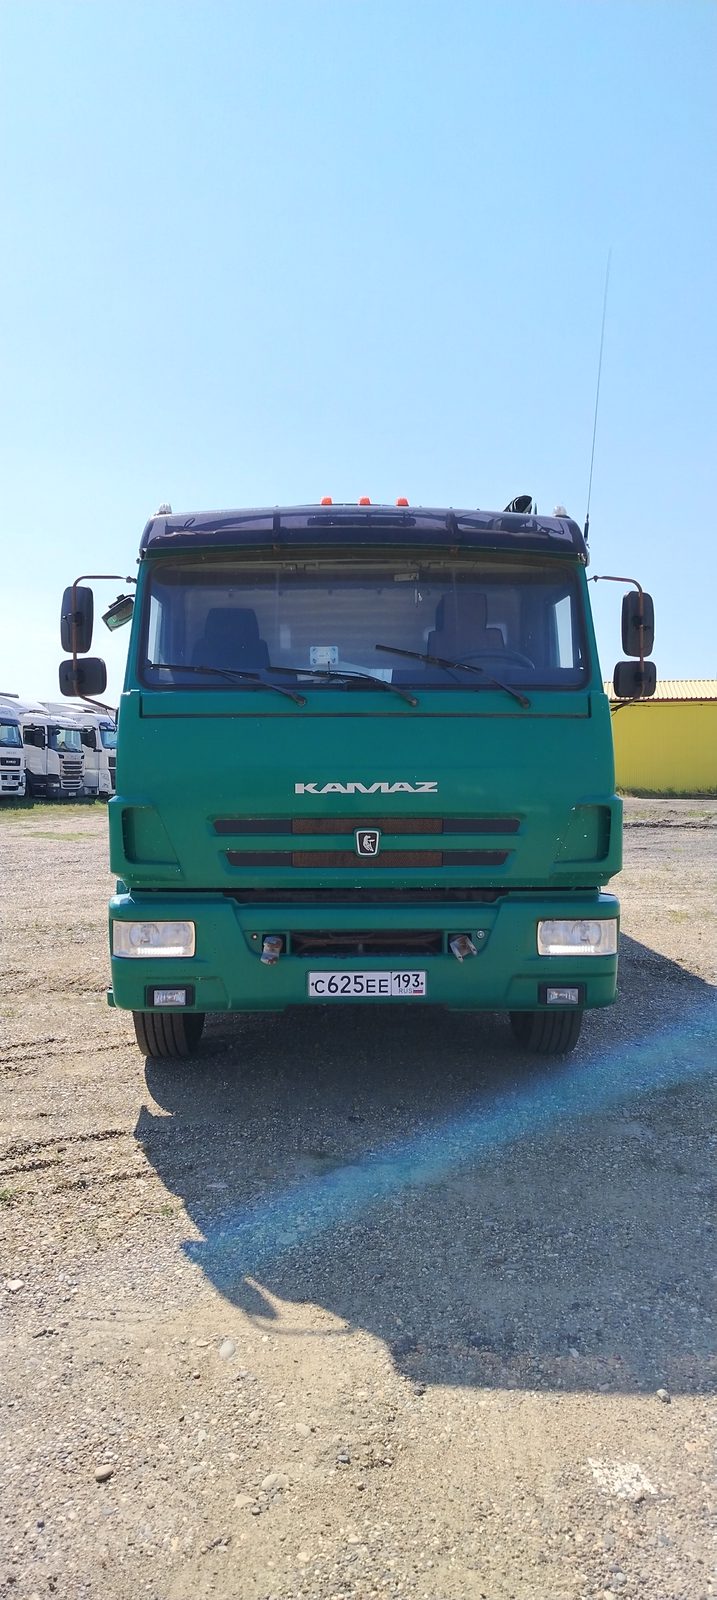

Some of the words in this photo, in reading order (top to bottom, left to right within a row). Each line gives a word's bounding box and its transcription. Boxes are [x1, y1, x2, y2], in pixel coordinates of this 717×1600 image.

[294, 781, 438, 794] KAMAZ
[314, 975, 389, 993] C625EE
[393, 974, 420, 988] 193
